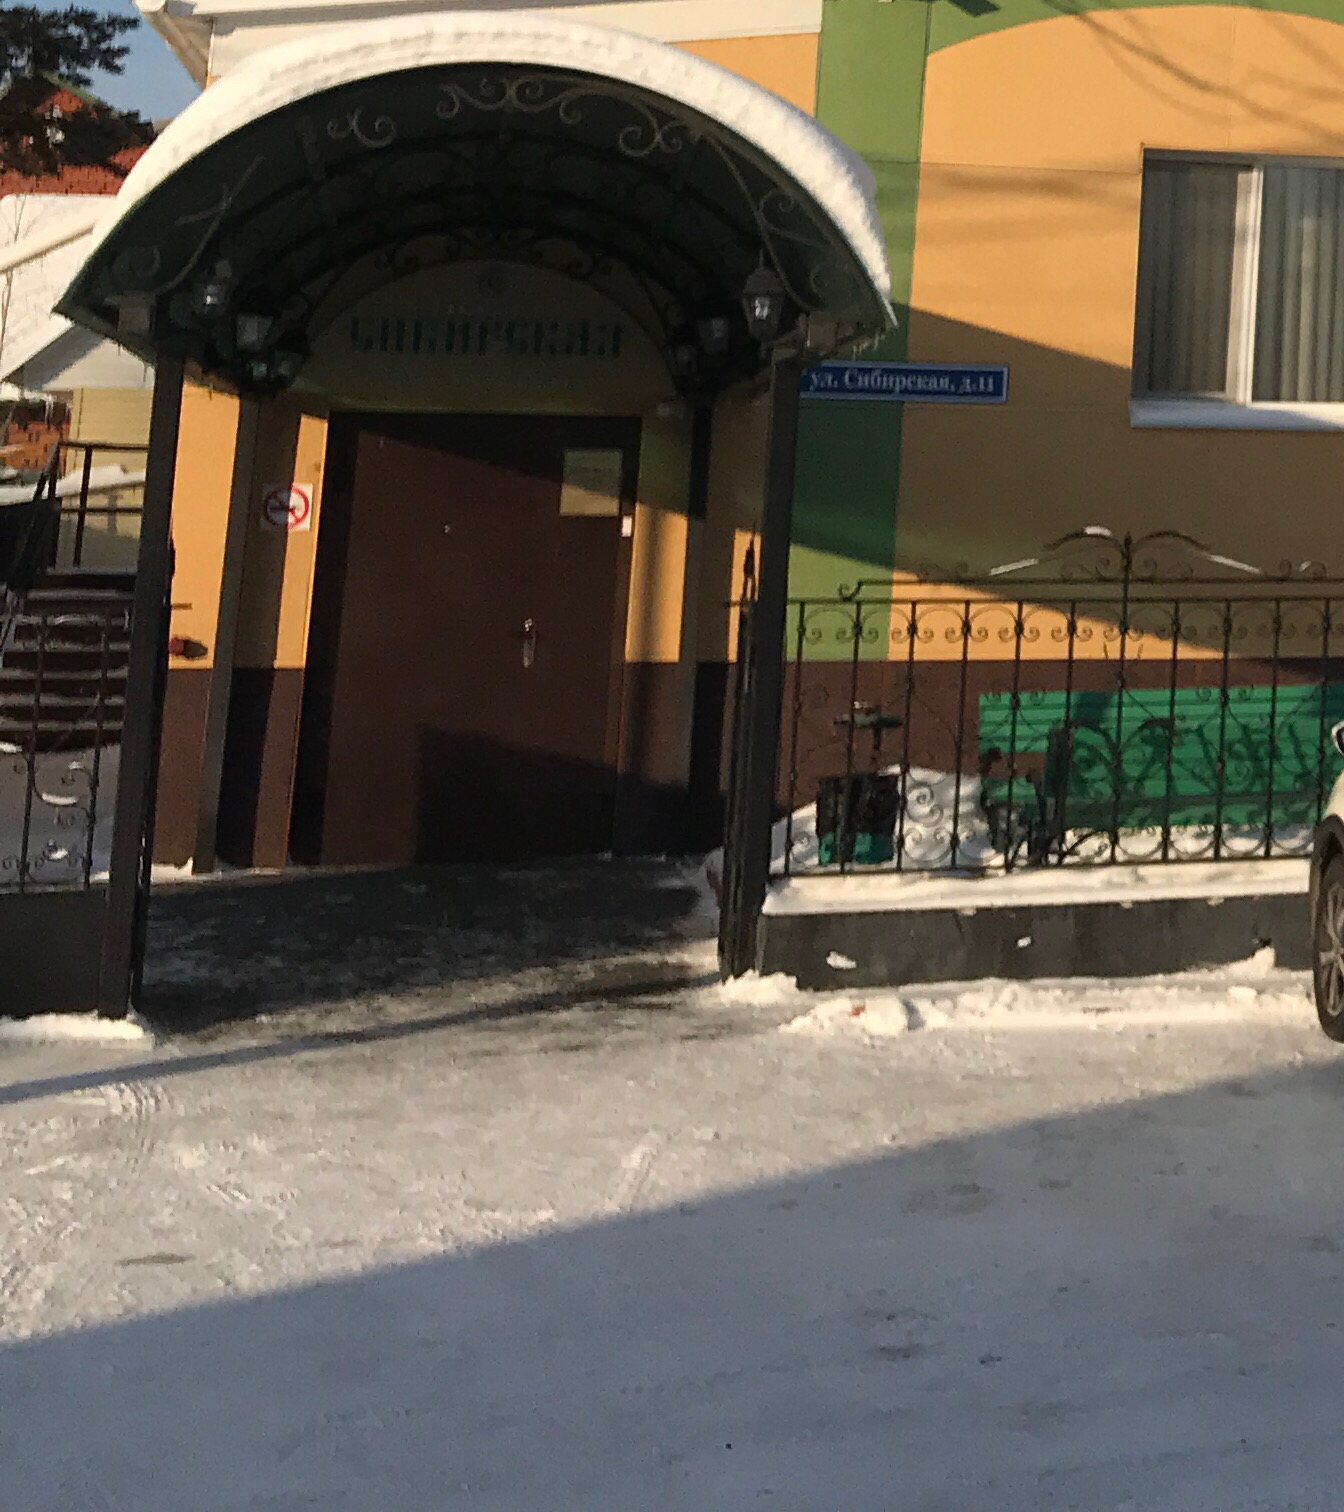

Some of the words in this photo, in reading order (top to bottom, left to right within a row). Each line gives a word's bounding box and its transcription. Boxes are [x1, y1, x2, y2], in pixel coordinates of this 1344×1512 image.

[350, 316, 622, 356] СИБИРСКАЯ
[809, 369, 838, 391] ул.
[958, 374, 994, 394] д.11
